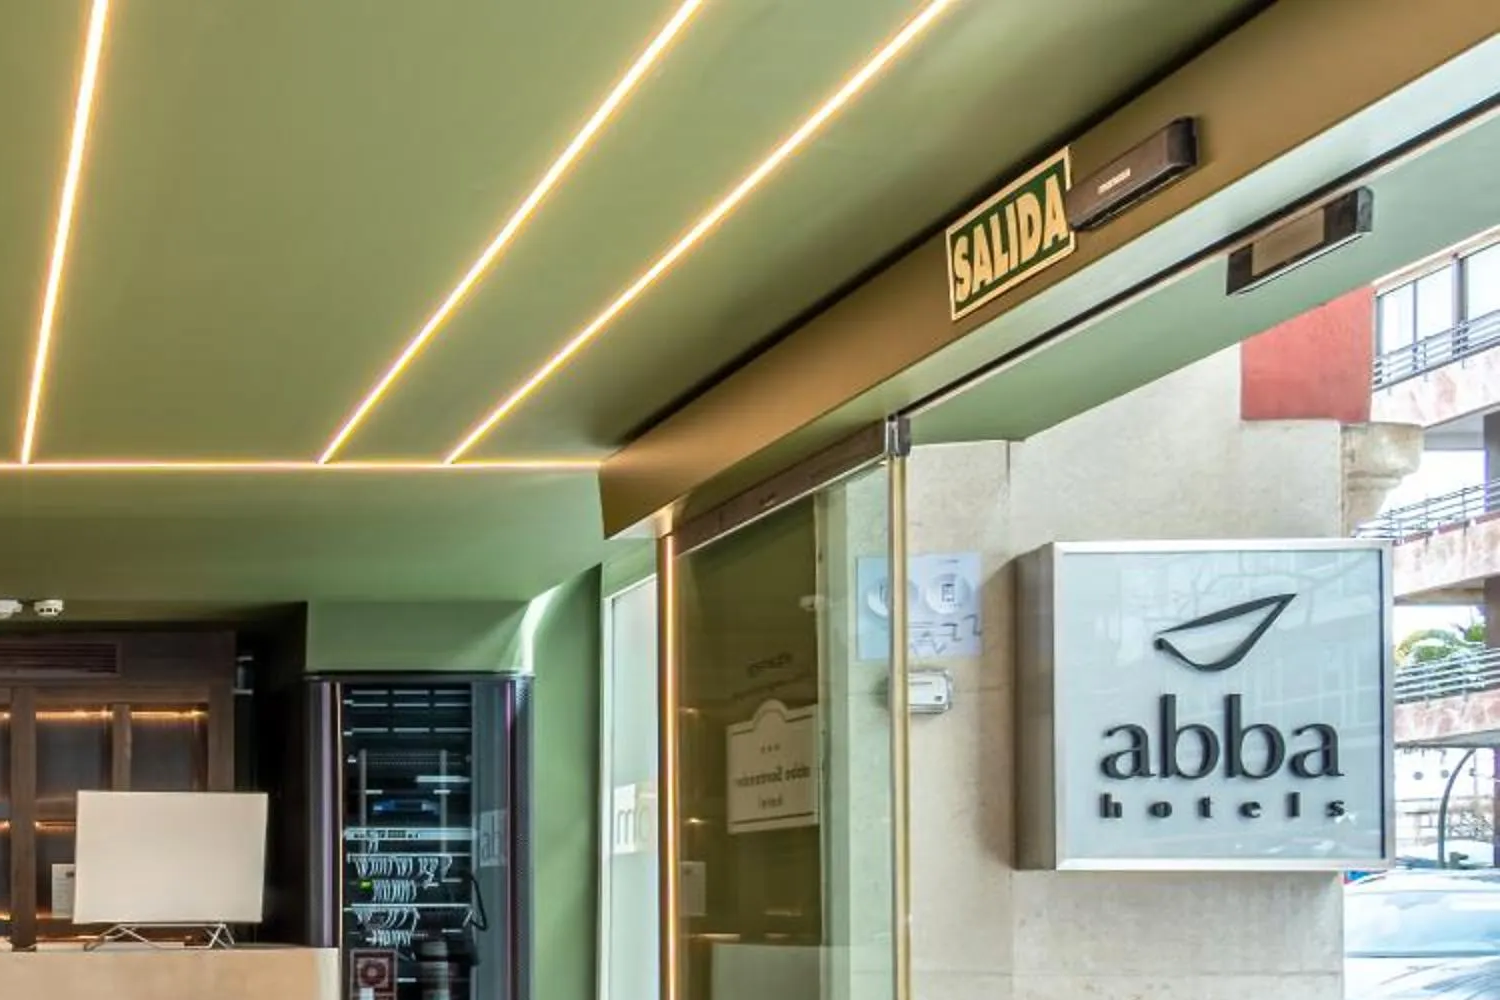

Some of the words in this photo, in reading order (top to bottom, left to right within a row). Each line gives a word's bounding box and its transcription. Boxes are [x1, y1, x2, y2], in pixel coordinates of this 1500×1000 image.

[953, 173, 1069, 303] SALIDA
[1099, 692, 1345, 780] abba
[1098, 791, 1347, 819] hotels
